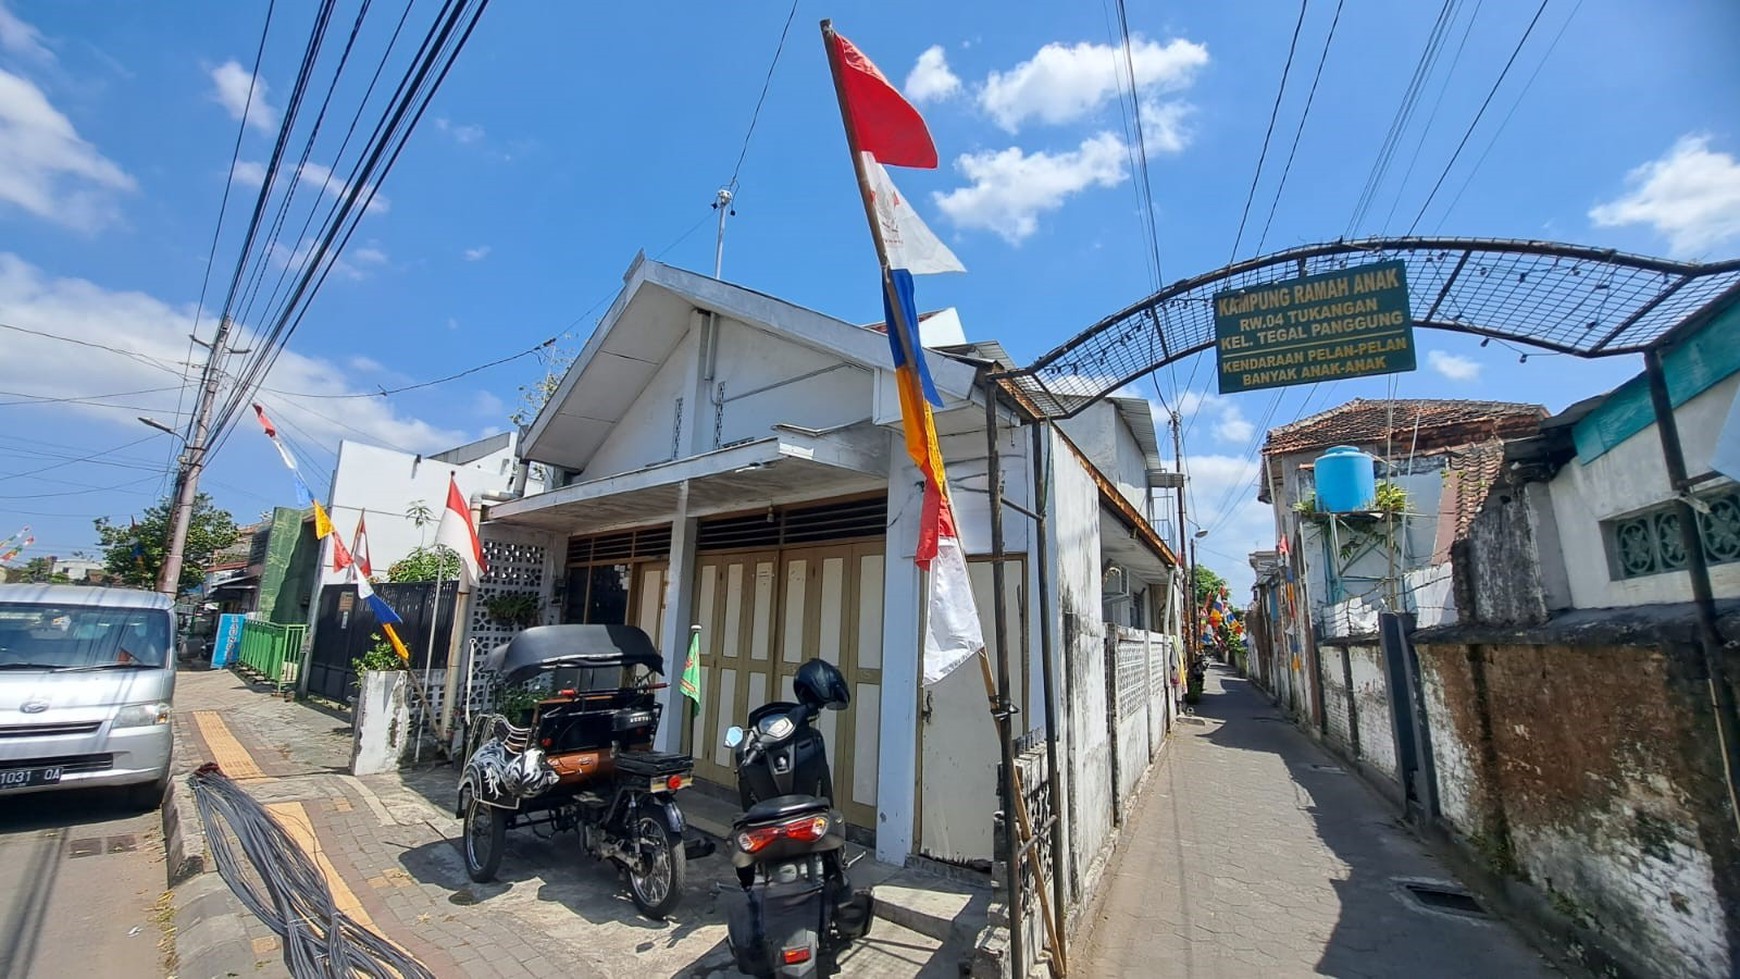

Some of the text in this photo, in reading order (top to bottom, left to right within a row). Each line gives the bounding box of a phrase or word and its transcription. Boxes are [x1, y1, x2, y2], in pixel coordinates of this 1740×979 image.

[1218, 268, 1399, 317] KAMPUNG RAMAH ANAK
[1221, 310, 1404, 350] KEL. TEGAL PANGGUNG
[1240, 297, 1378, 331] RW.04 TUKANGAN
[1222, 337, 1407, 373] KENDARAAN PELAN-PELAN
[1243, 356, 1387, 387] BANYAK ANAK-ANAK
[223, 615, 240, 662] LAUND
[1, 770, 31, 784] 1031
